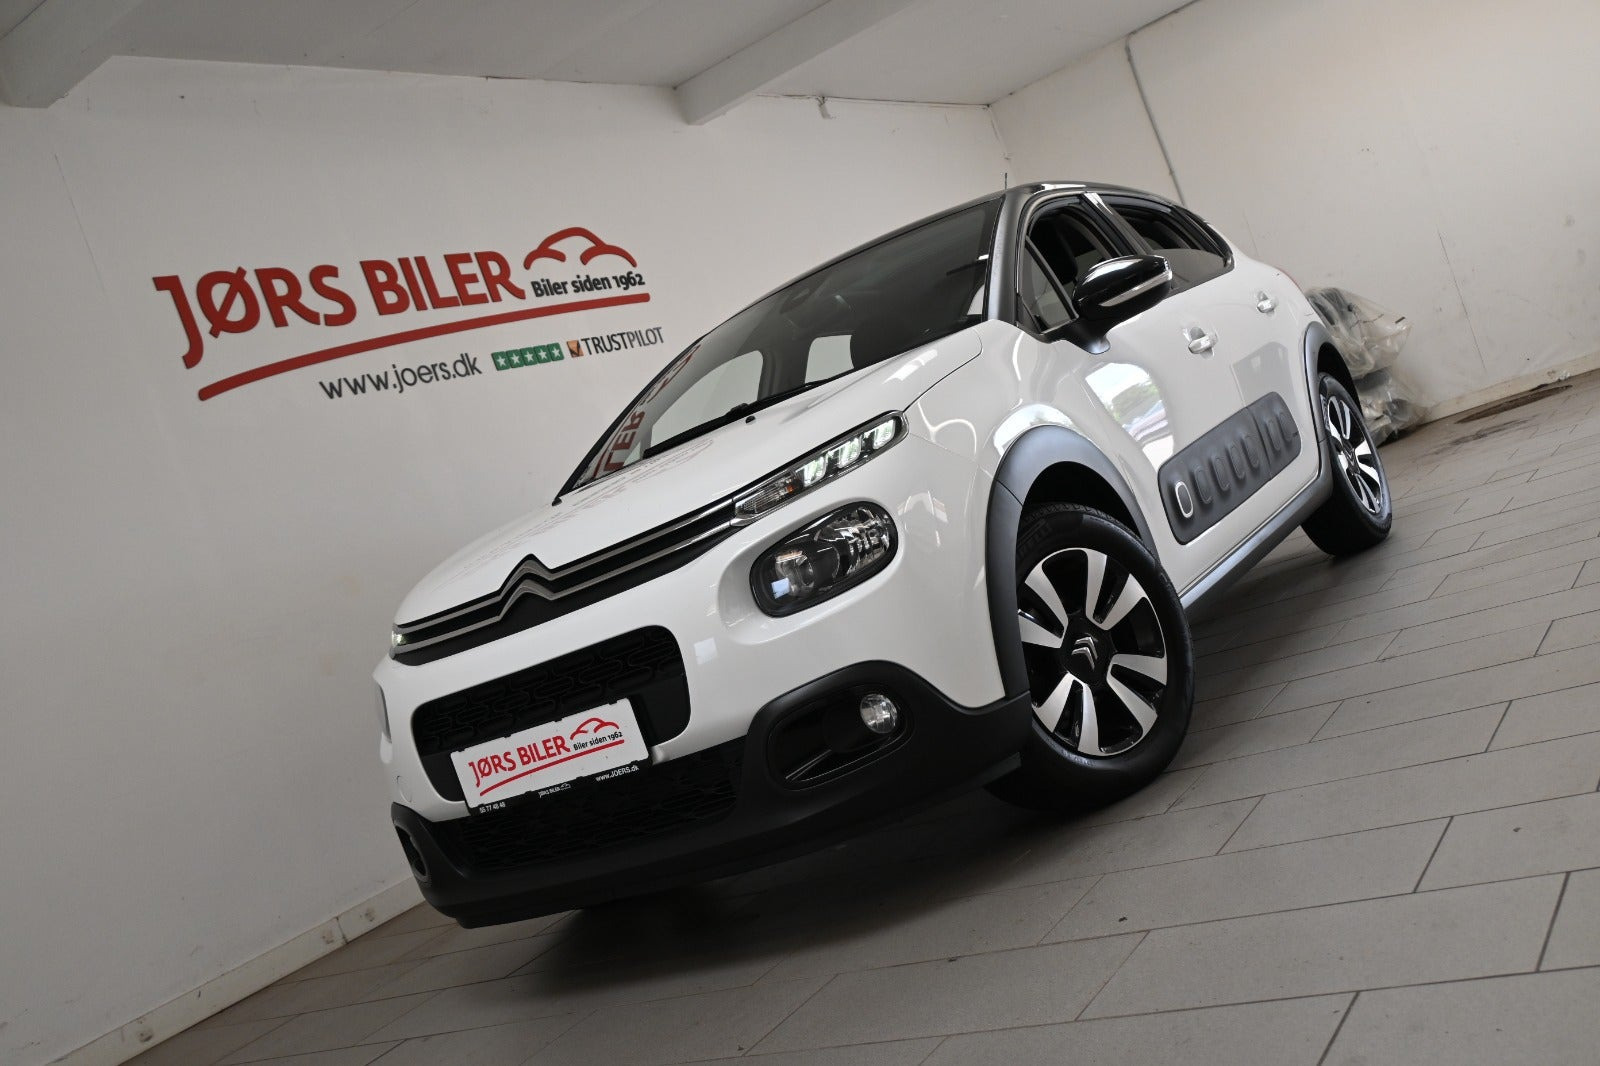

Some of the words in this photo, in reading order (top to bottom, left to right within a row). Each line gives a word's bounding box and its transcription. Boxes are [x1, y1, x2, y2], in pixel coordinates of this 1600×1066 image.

[531, 278, 568, 297] Biler
[571, 274, 612, 293] siden
[612, 271, 645, 291] 1962
[152, 265, 358, 370] JØRS
[359, 251, 526, 316] BILER
[581, 326, 664, 356] TRUSTPILOT
[318, 352, 483, 400] www.joers.dk
[573, 742, 588, 751] Biler
[589, 735, 608, 746] siden
[607, 731, 623, 741] 1962
[468, 751, 517, 788] JØRS
[517, 735, 571, 766] BILER
